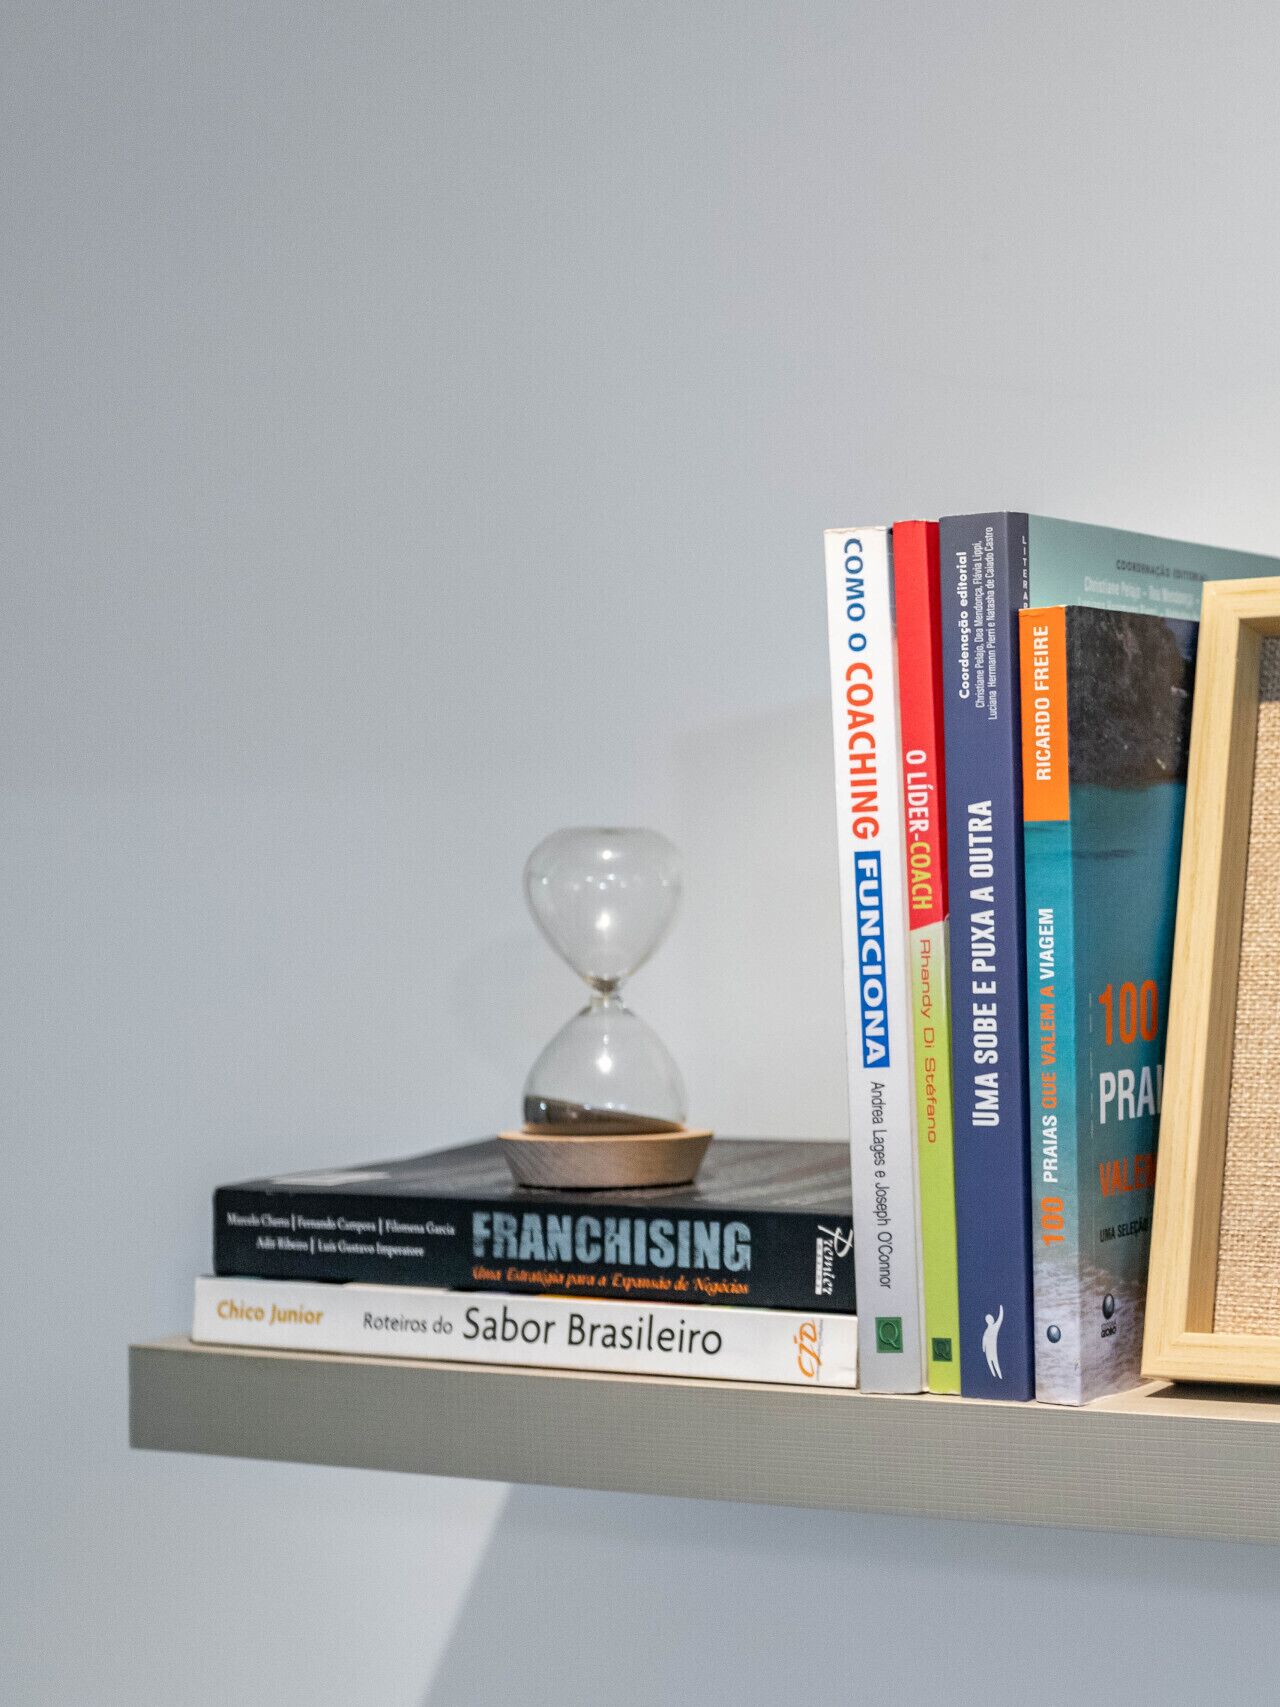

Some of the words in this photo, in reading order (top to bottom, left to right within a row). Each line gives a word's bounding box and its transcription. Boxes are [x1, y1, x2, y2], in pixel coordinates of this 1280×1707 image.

[971, 541, 984, 562] Lippi,
[984, 526, 994, 551] Castro
[844, 538, 866, 622] COMO
[956, 551, 968, 606] editorial
[972, 562, 983, 585] Flávia
[984, 552, 995, 578] Caiado
[984, 579, 995, 590] de
[973, 585, 985, 627] Mendonça,
[985, 590, 996, 620] Natasha
[848, 632, 867, 652] O
[957, 610, 972, 699] Coordenação
[973, 627, 984, 643] Dea
[974, 643, 985, 669] Pelajo,
[986, 628, 996, 649] Pierri
[986, 650, 997, 688] Herrmann
[1033, 625, 1050, 691] FREIRE
[974, 669, 985, 708] Christiane
[987, 690, 998, 720] Luciana
[845, 662, 880, 840] COACHING
[905, 749, 927, 765] O
[1034, 697, 1051, 780] RICARDO
[906, 772, 934, 910] LÍDER-COACH
[967, 800, 994, 879] OUTRA
[969, 886, 994, 902] A
[857, 858, 886, 1065] FUNCIONA
[970, 909, 996, 973] PUXA
[1038, 908, 1055, 980] VIAGEM
[920, 939, 933, 1019] Rhandy
[972, 980, 997, 994] E
[1040, 985, 1055, 998] A
[972, 1003, 998, 1064] SOBE
[1040, 1003, 1057, 1065] VALEM
[1098, 979, 1158, 1046] 100
[923, 1028, 935, 1049] Di
[870, 1081, 886, 1125] Andrea
[924, 1057, 937, 1143] Stéfano
[972, 1072, 1000, 1127] UMA
[1041, 1071, 1057, 1109] QUE
[869, 1129, 886, 1167] Lages
[1042, 1115, 1058, 1183] PRAIAS
[874, 1170, 886, 1178] e
[873, 1182, 891, 1226] Joseph
[1041, 1196, 1066, 1246] 100
[472, 1211, 751, 1272] FRANCHISING
[817, 1225, 854, 1296] Premier
[877, 1231, 894, 1290] O'Connor
[472, 1265, 502, 1281] Uma
[564, 1273, 596, 1288] para
[597, 1275, 607, 1288] a
[673, 1275, 688, 1292] de
[216, 1300, 265, 1322] Chico
[269, 1302, 325, 1326] Junior
[363, 1312, 427, 1334] Roteiros
[432, 1315, 454, 1335] do
[462, 1306, 556, 1344] Sabor
[567, 1313, 723, 1355] Brasileiro
